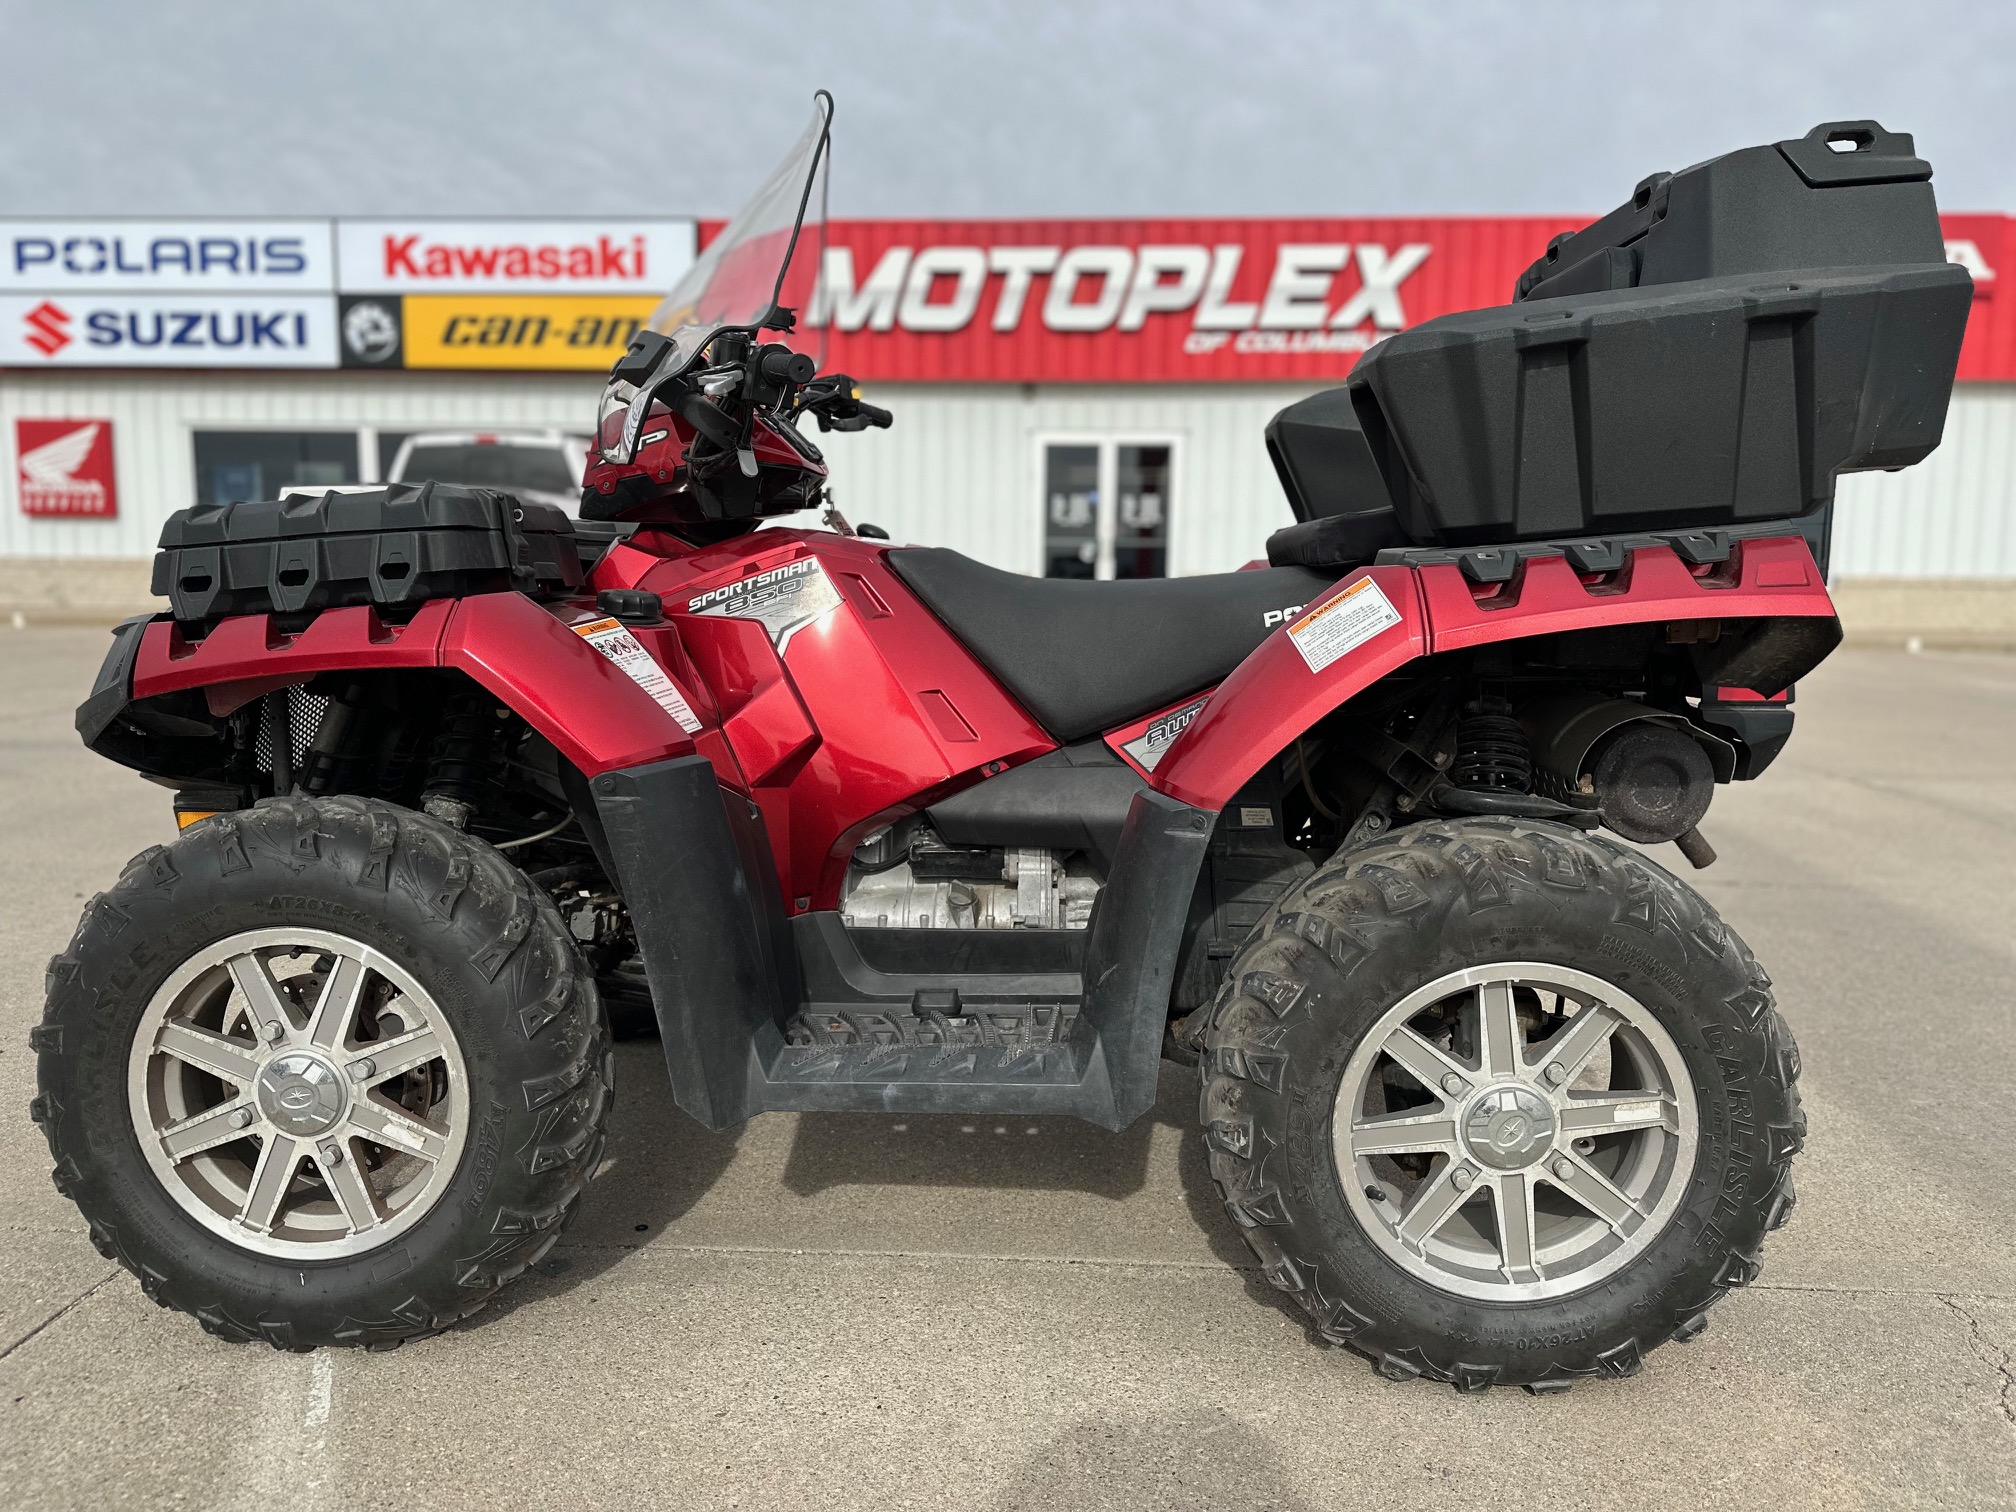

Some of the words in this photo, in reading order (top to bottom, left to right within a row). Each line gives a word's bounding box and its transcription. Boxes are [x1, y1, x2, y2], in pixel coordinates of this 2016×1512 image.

[14, 237, 307, 274] POLARIS
[385, 234, 645, 279] Kawasaki
[804, 244, 1430, 331] MOTOPLEX
[86, 309, 307, 347] SUZUKI
[1183, 331, 1230, 354] OF
[688, 556, 818, 612] SPORTSMAN
[724, 577, 803, 614] 850
[1315, 591, 1351, 615] WARNING
[1263, 603, 1308, 628] PO
[468, 1116, 501, 1196] 489
[1691, 1020, 1754, 1258] CARLISLE
